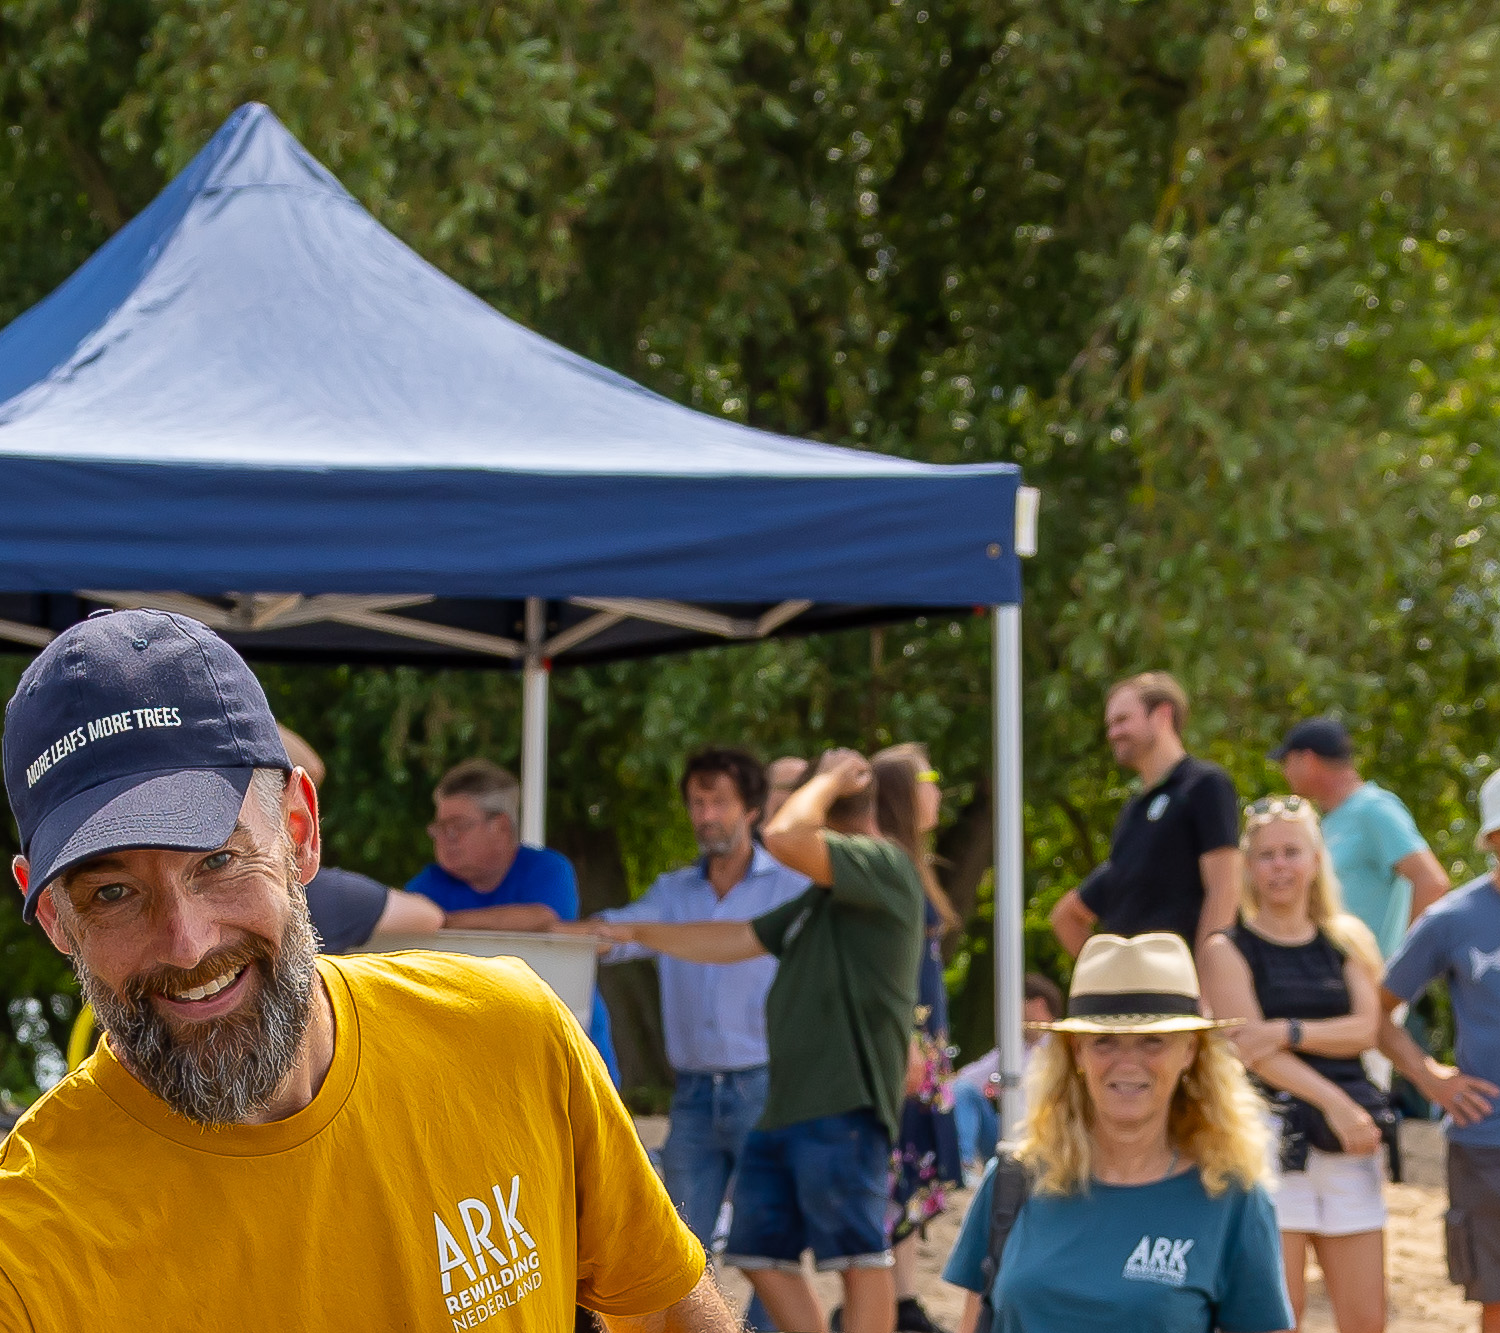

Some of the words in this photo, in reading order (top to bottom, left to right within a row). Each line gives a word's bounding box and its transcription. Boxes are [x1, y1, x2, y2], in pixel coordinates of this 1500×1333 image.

[26, 749, 53, 788] MORE
[51, 726, 87, 765] LEAFS
[88, 711, 133, 742] MORE
[133, 707, 182, 729] TREES
[433, 1174, 537, 1295] ARK
[1123, 1235, 1194, 1273] ARK
[445, 1251, 540, 1315] REWILDING
[452, 1271, 543, 1333] NEDERLAND
